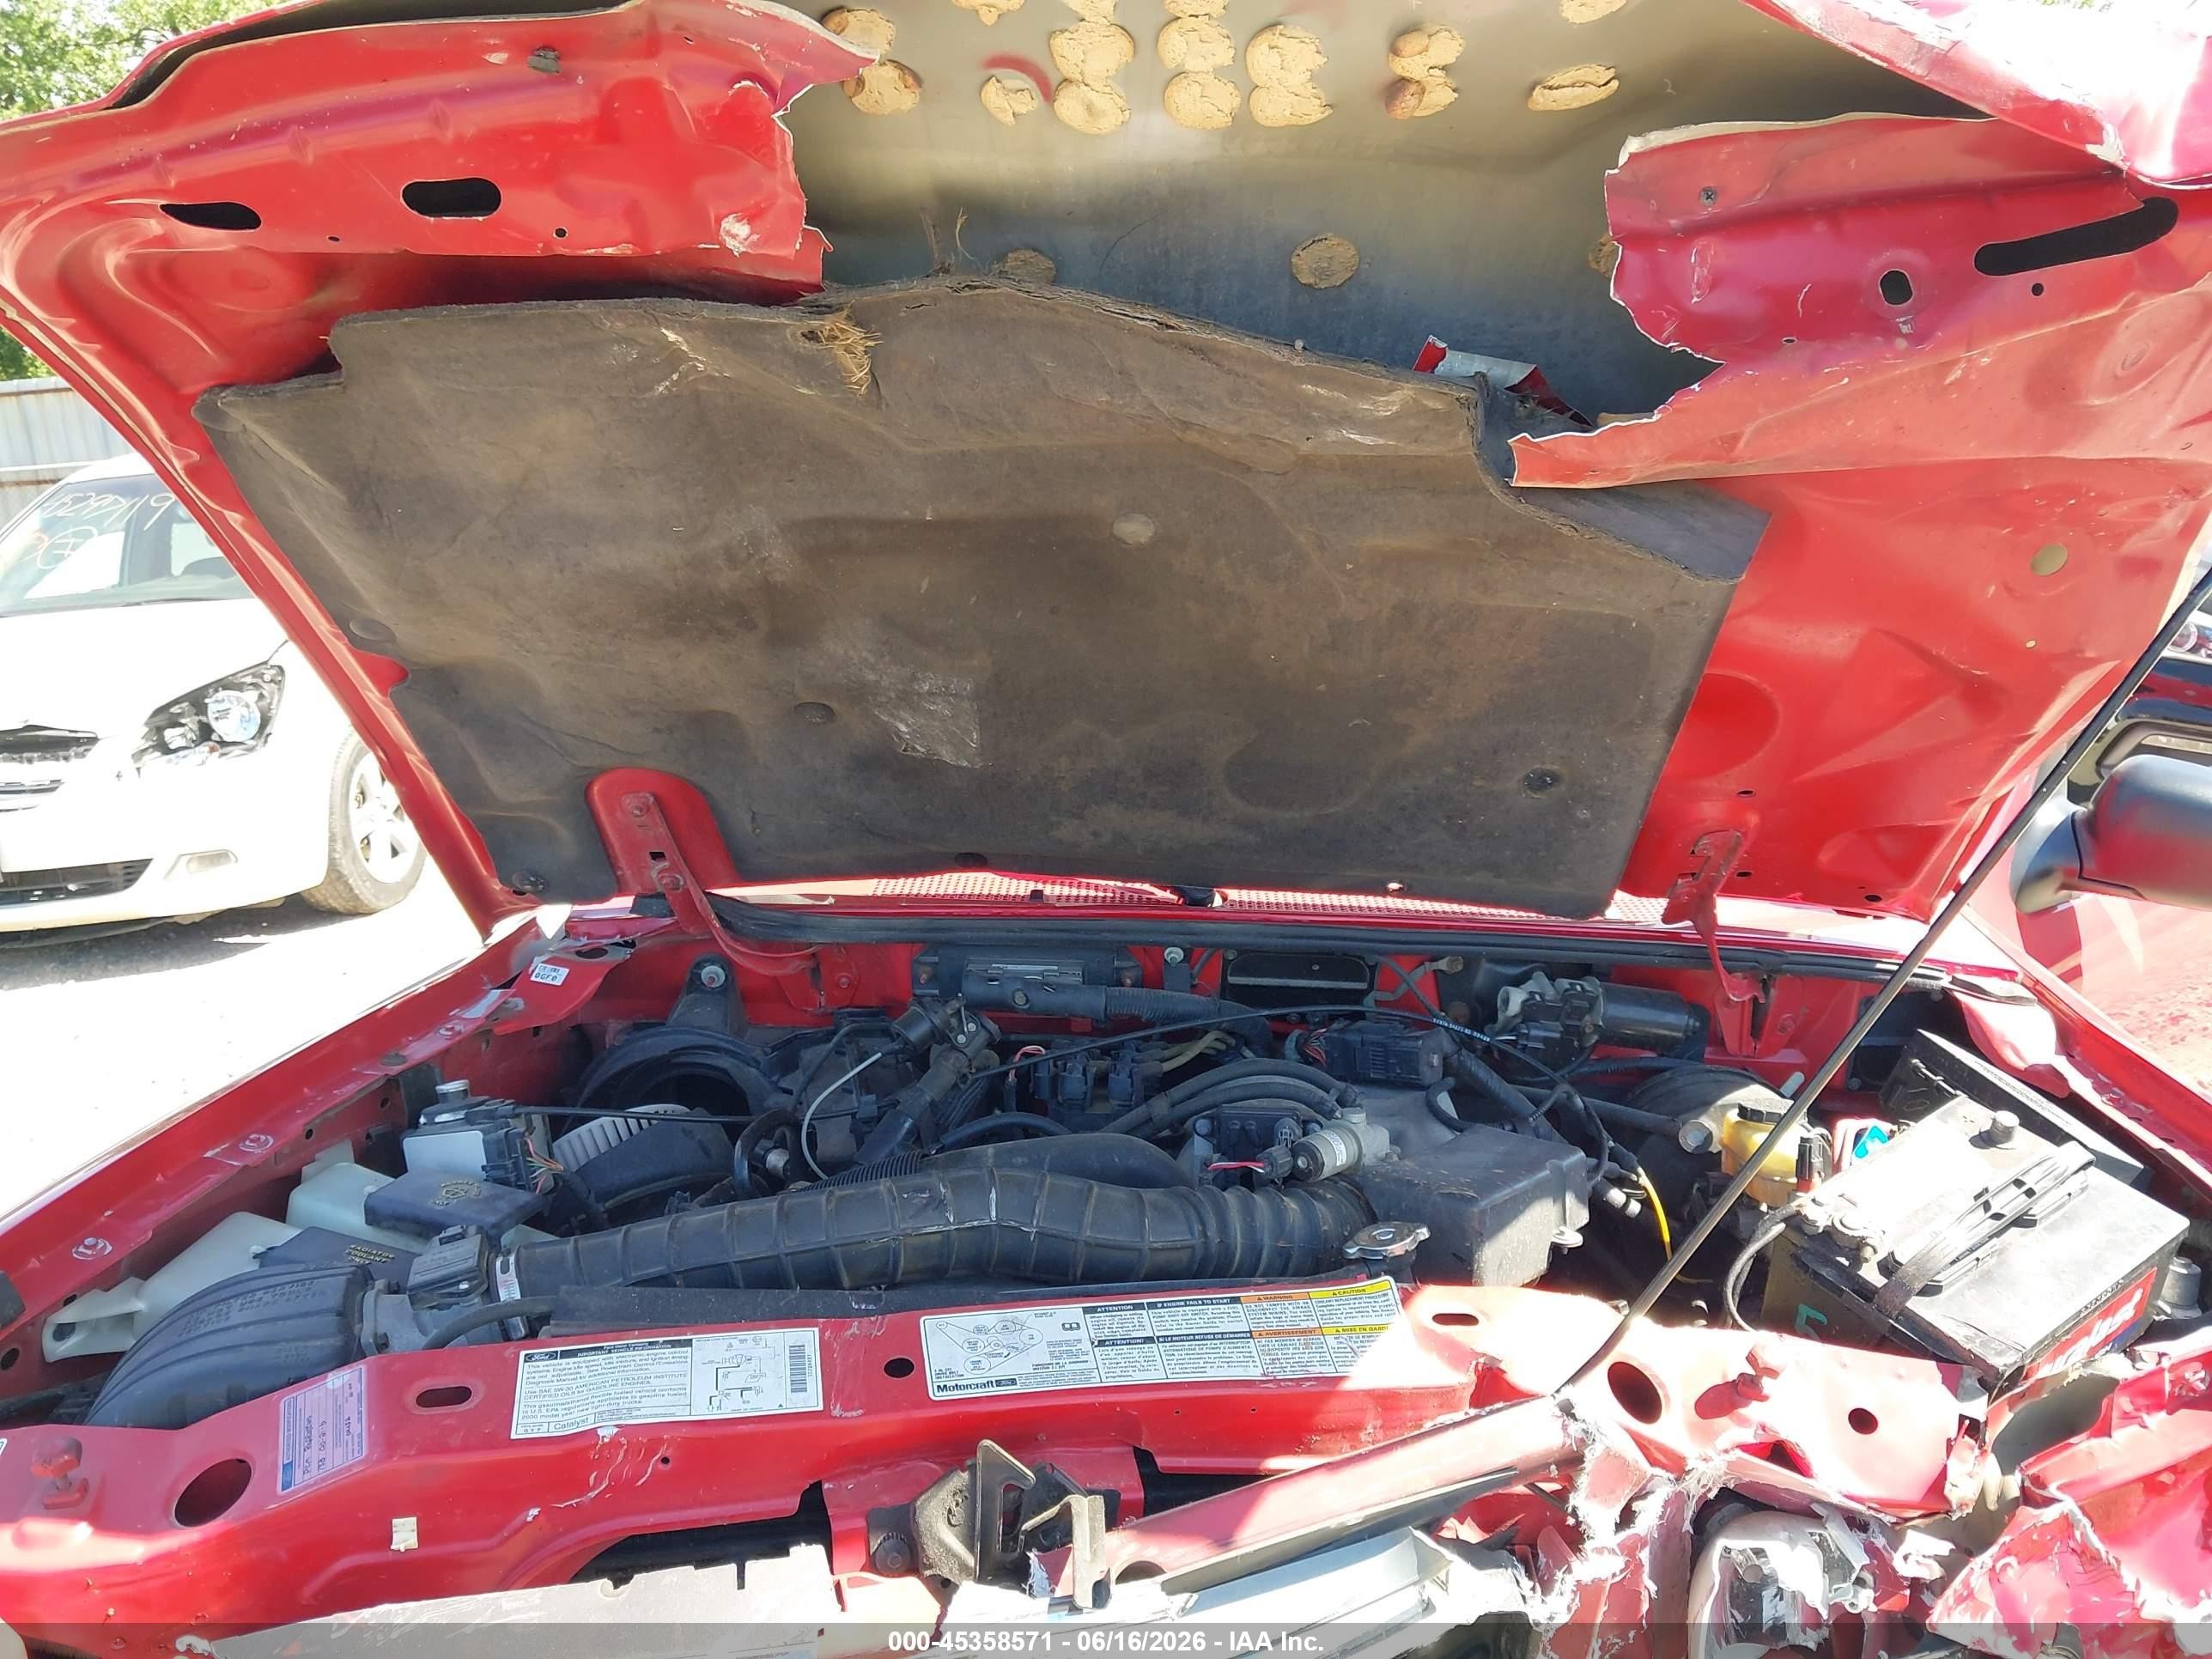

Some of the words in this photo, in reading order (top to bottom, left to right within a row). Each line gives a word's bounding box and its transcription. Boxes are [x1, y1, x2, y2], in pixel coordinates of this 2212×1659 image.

[344, 1249, 392, 1263] COOLANT
[574, 1380, 609, 1389] AMERICAN
[586, 1382, 618, 1392] GASOLINE
[936, 1379, 994, 1393] Motorcraft
[561, 1401, 595, 1412] regulations
[553, 1416, 588, 1430] Catalyst
